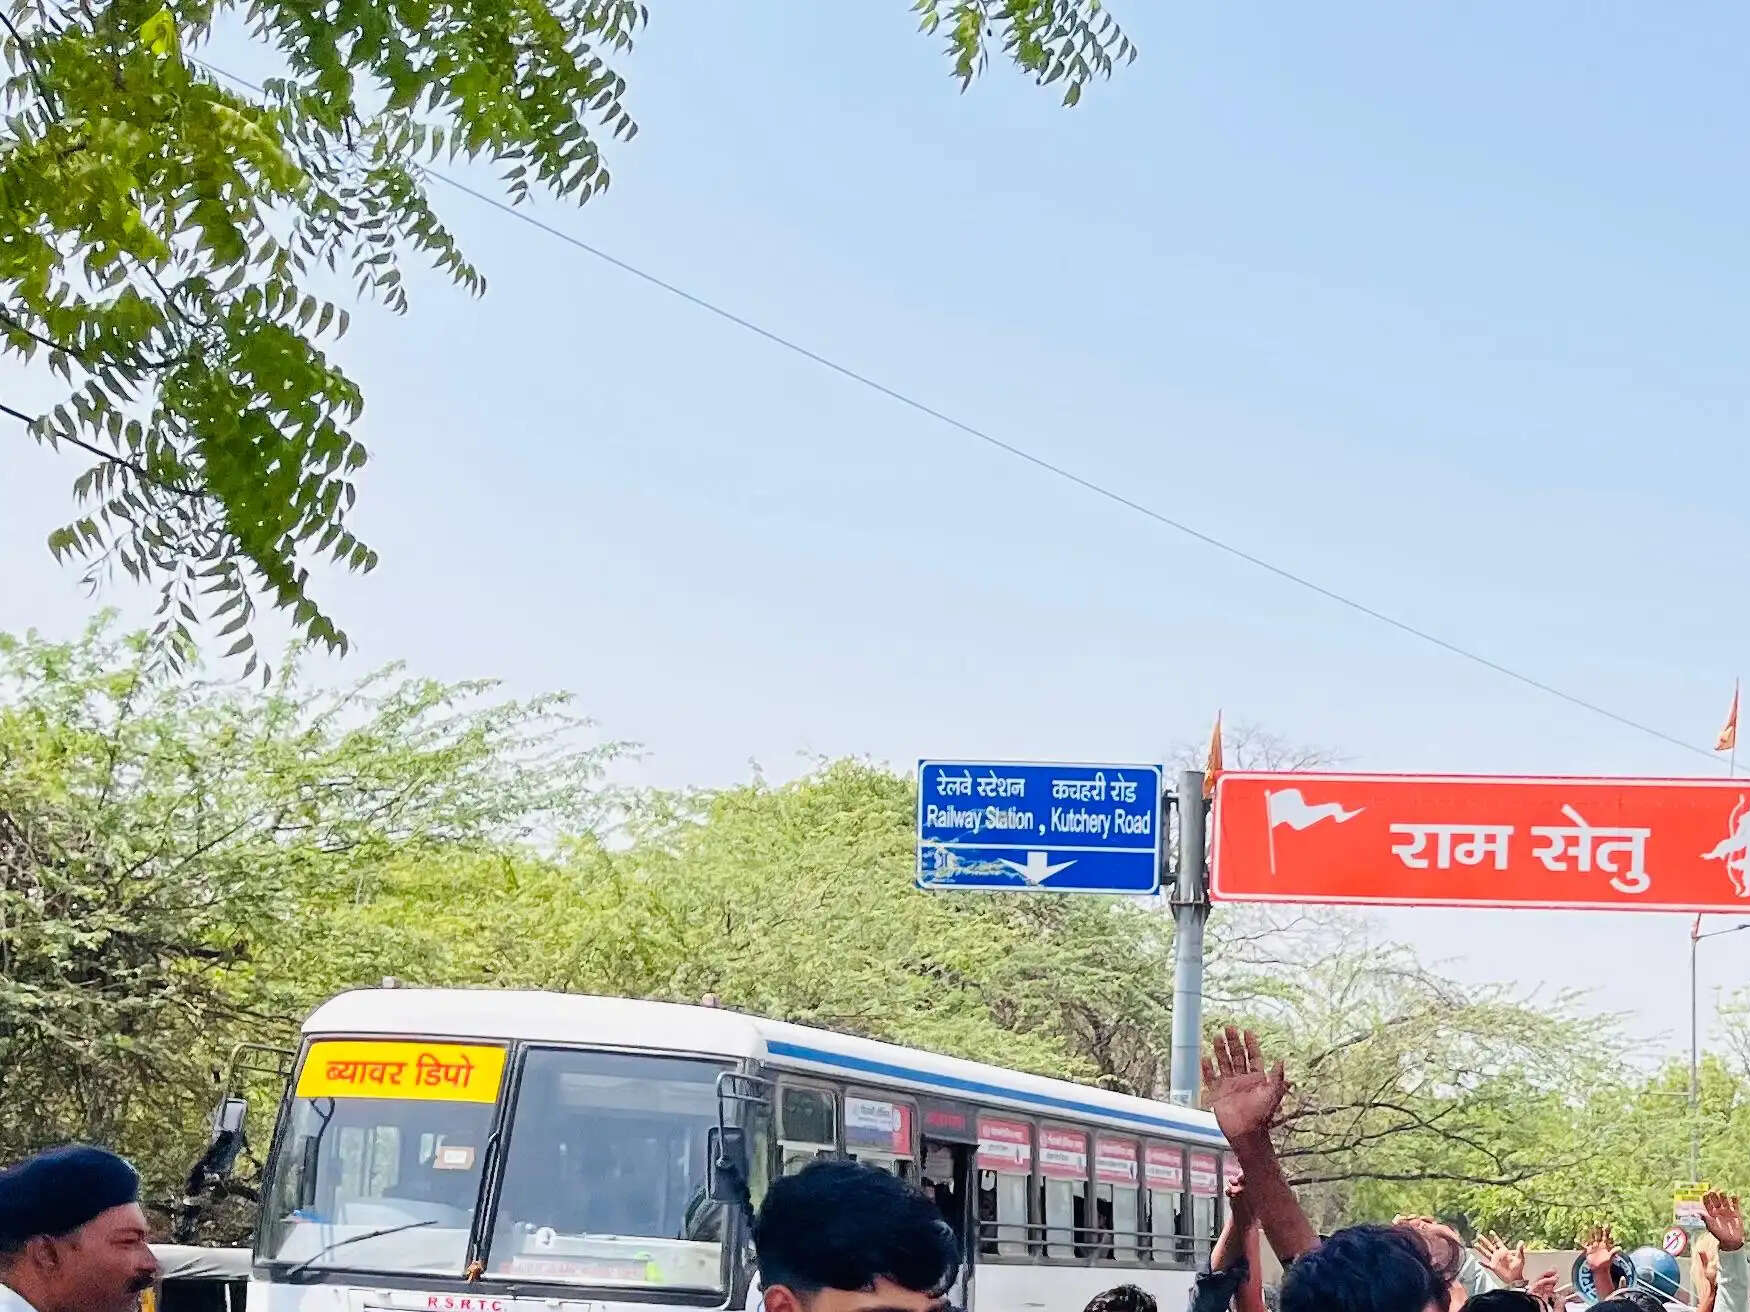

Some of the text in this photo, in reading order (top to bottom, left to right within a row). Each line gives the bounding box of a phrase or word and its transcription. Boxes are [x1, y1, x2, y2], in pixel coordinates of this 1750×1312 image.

[935, 768, 1026, 798] रेलवे स्टेशन
[1051, 771, 1138, 803] कचहरी रोड
[926, 804, 982, 834] Railway
[1051, 806, 1112, 840] Kutchery
[1114, 808, 1152, 835] Road
[1390, 803, 1652, 894] राम सेतु
[325, 1052, 475, 1089] ब्यावर डिपो
